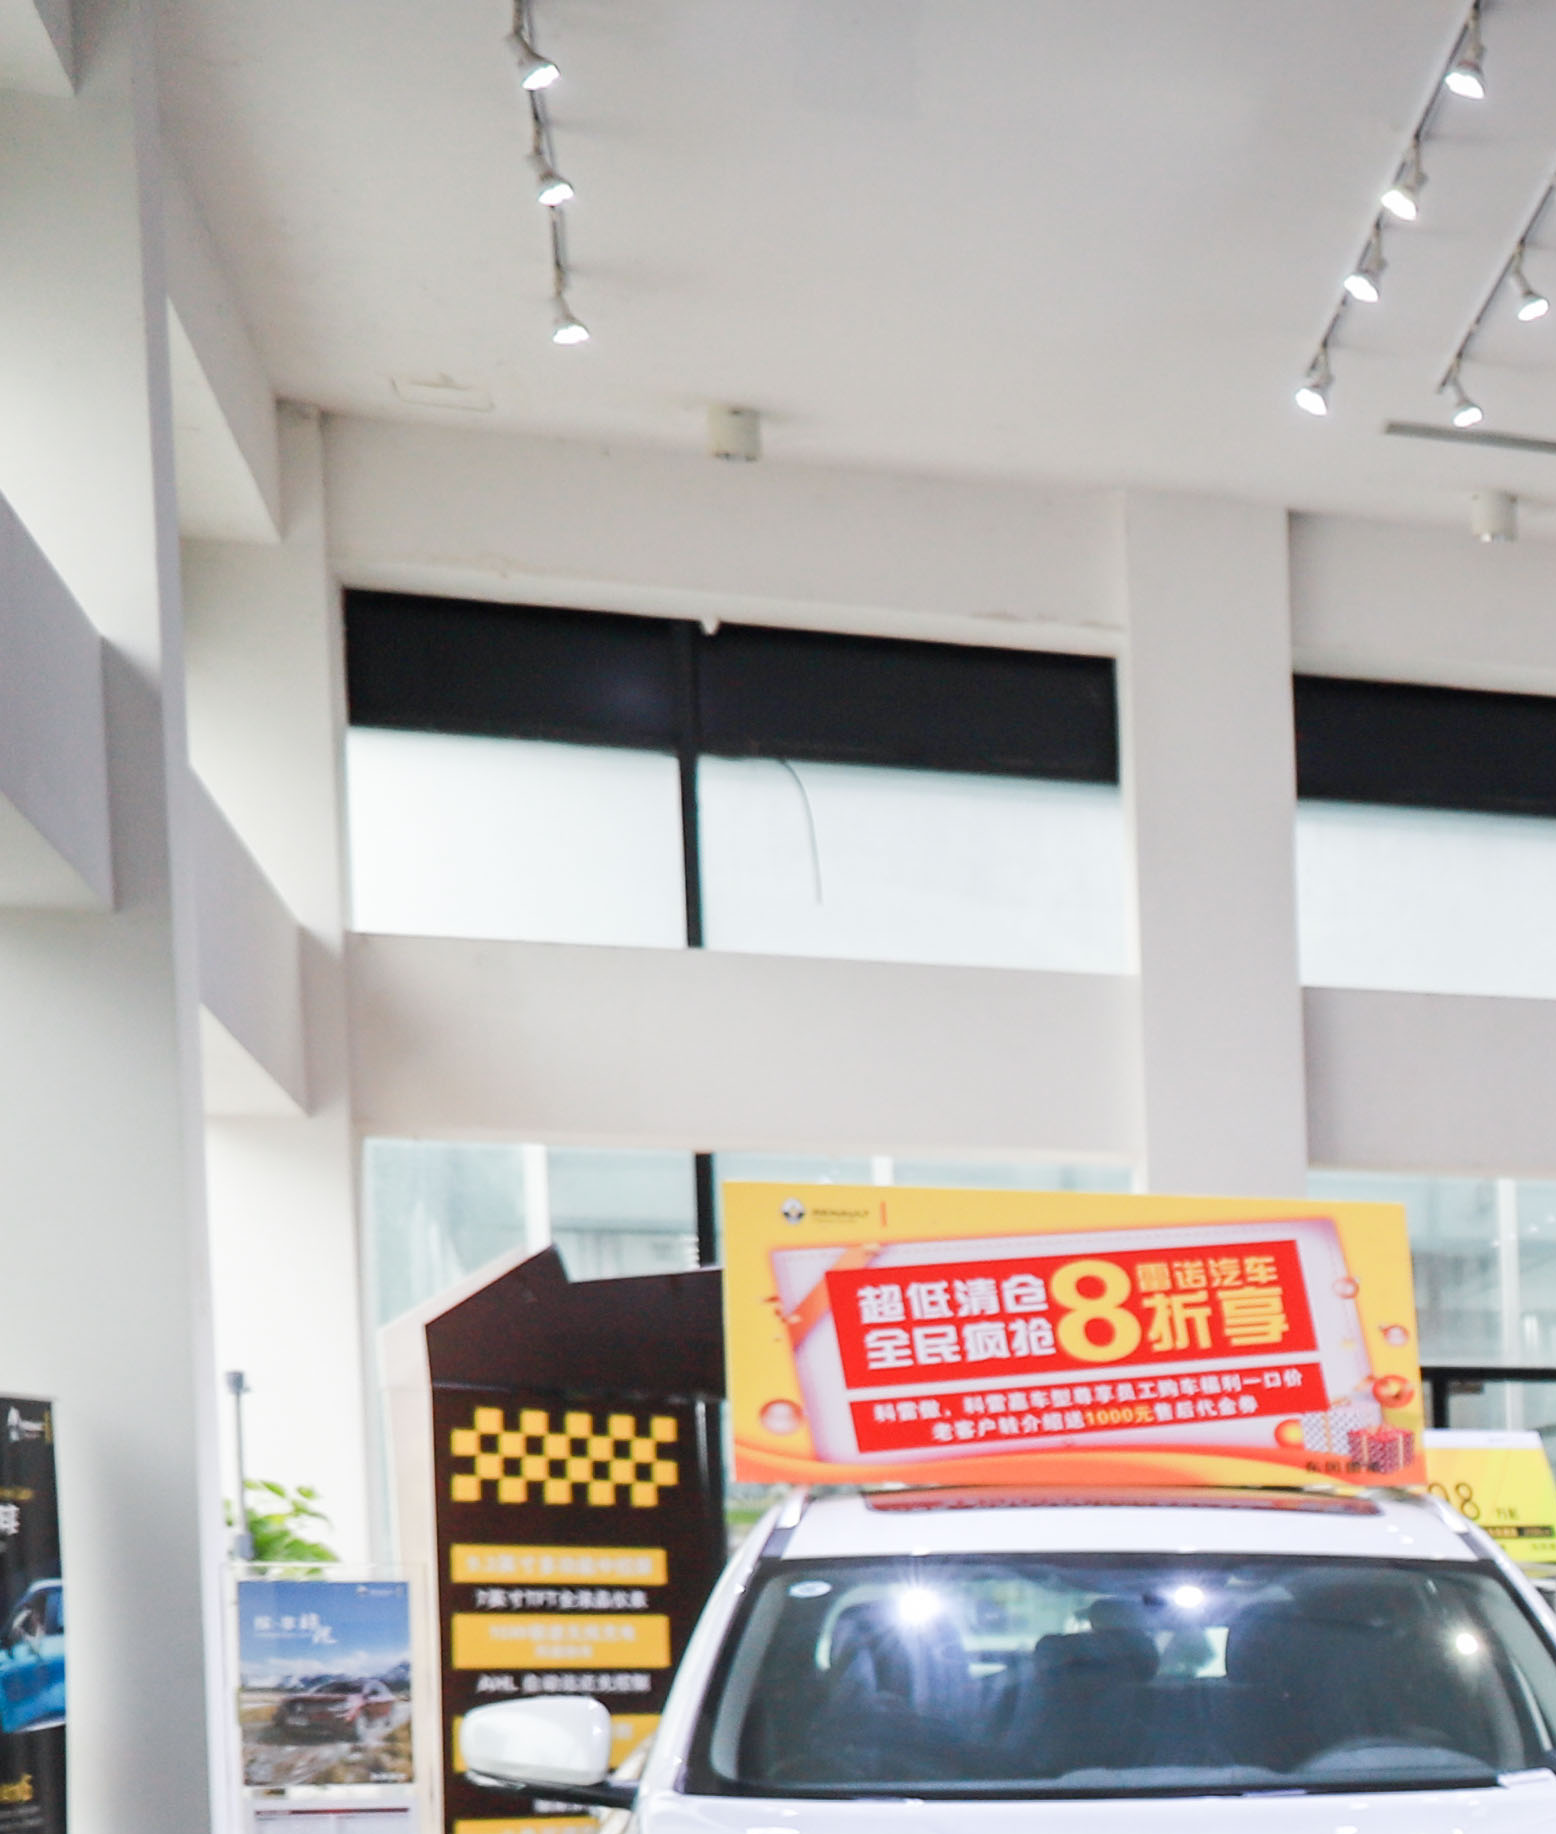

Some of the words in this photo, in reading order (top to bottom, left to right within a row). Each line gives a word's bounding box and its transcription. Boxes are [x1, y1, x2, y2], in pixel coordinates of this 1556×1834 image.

[857, 1273, 1050, 1325] 超低清仓
[1135, 1255, 1280, 1293] 雷诺汽车
[1050, 1259, 1142, 1363] 8
[1144, 1286, 1290, 1352] 折享
[863, 1318, 1057, 1371] 全民疯抢
